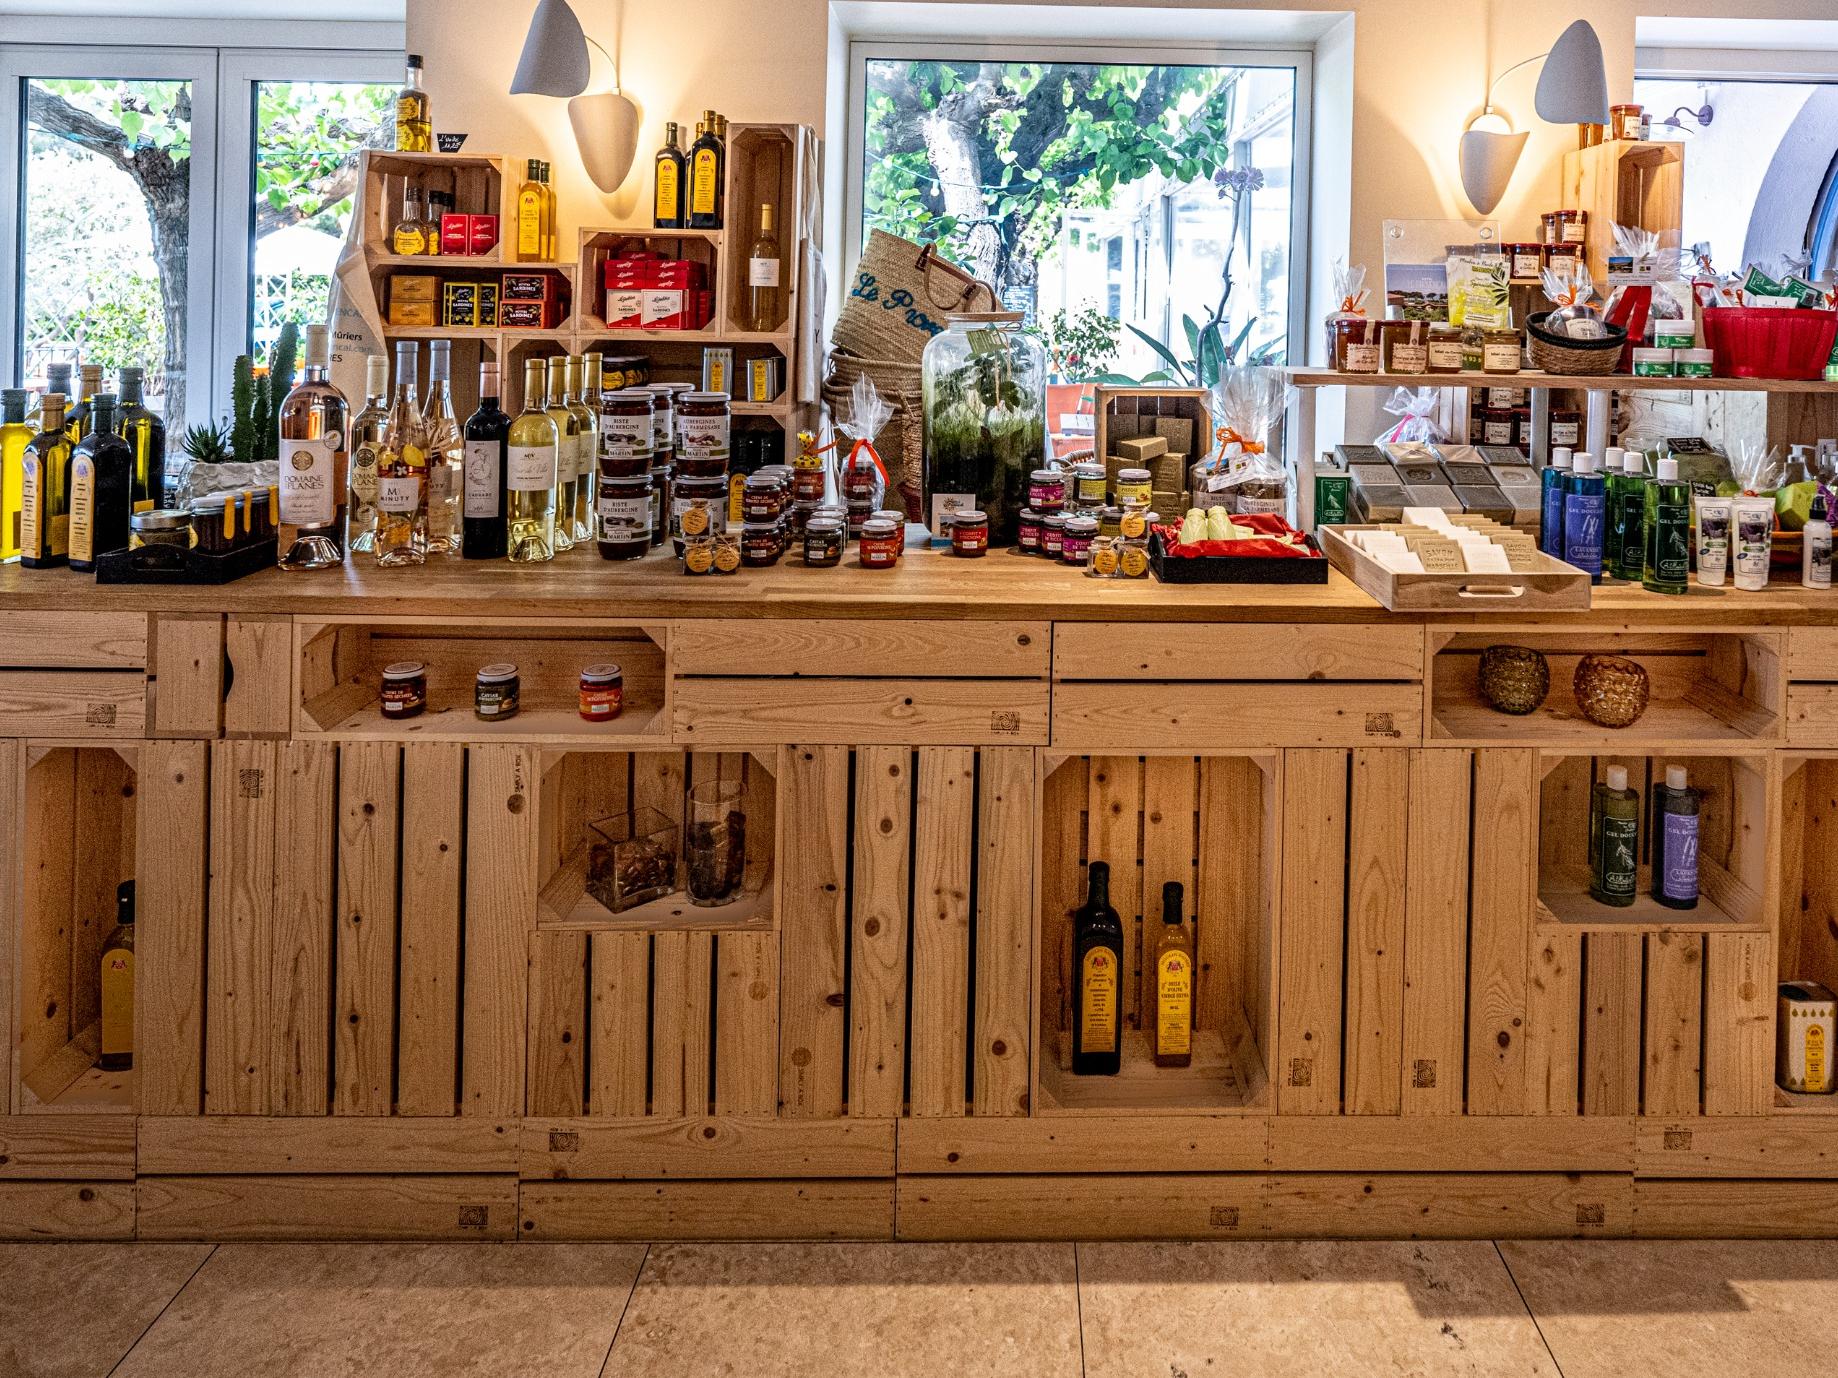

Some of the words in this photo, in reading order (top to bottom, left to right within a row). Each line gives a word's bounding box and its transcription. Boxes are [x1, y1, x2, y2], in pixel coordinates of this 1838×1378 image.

[852, 272, 878, 302] Le
[284, 475, 323, 483] DOMAINE
[1425, 549, 1454, 557] SAVON
